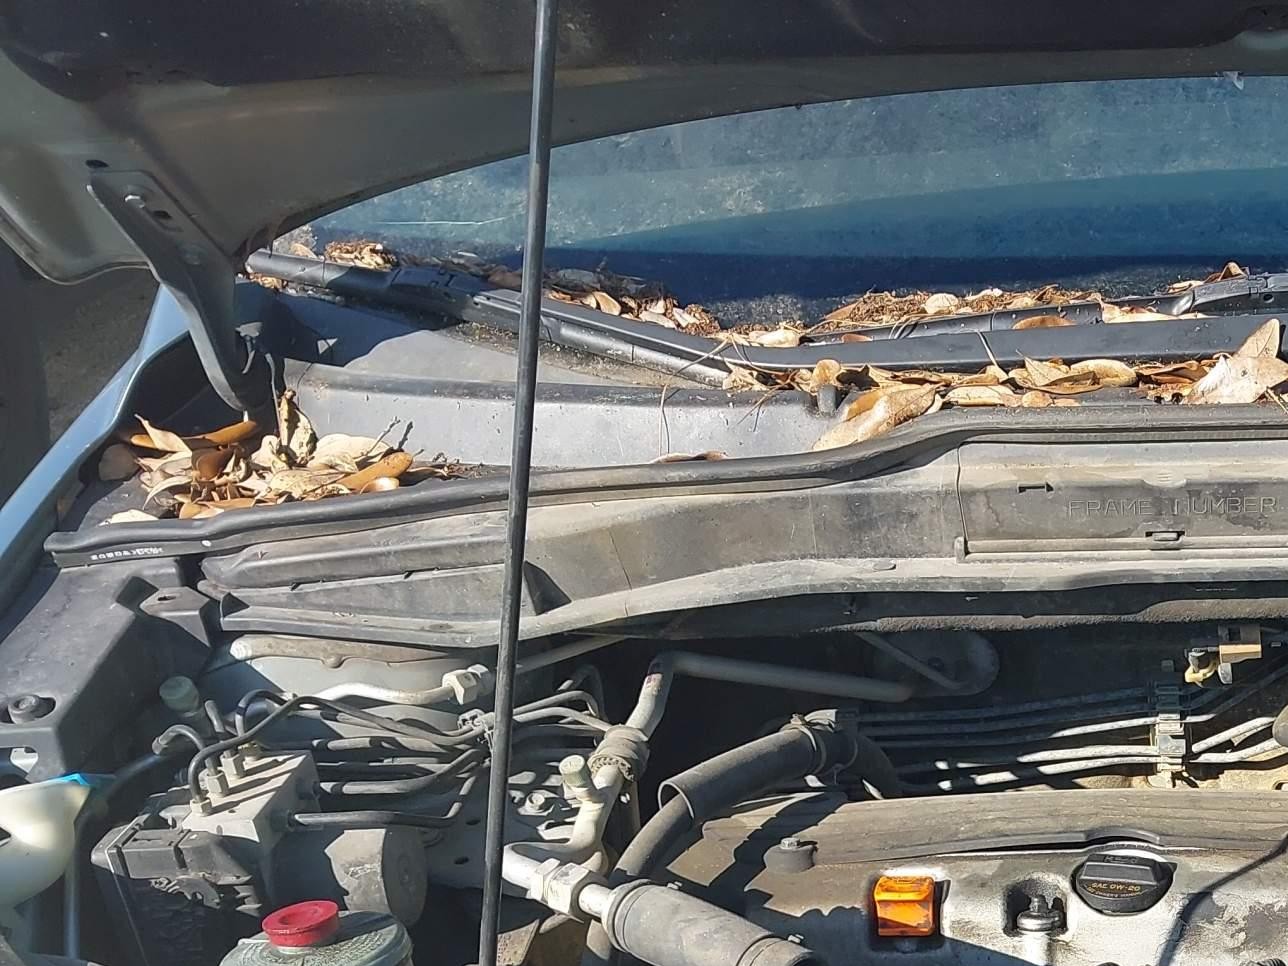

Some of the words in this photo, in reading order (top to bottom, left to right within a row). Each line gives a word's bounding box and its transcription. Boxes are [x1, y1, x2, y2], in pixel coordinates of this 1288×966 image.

[1067, 498, 1153, 517] FRAME
[1173, 496, 1277, 516] NUMBER
[1091, 882, 1109, 890] SAE
